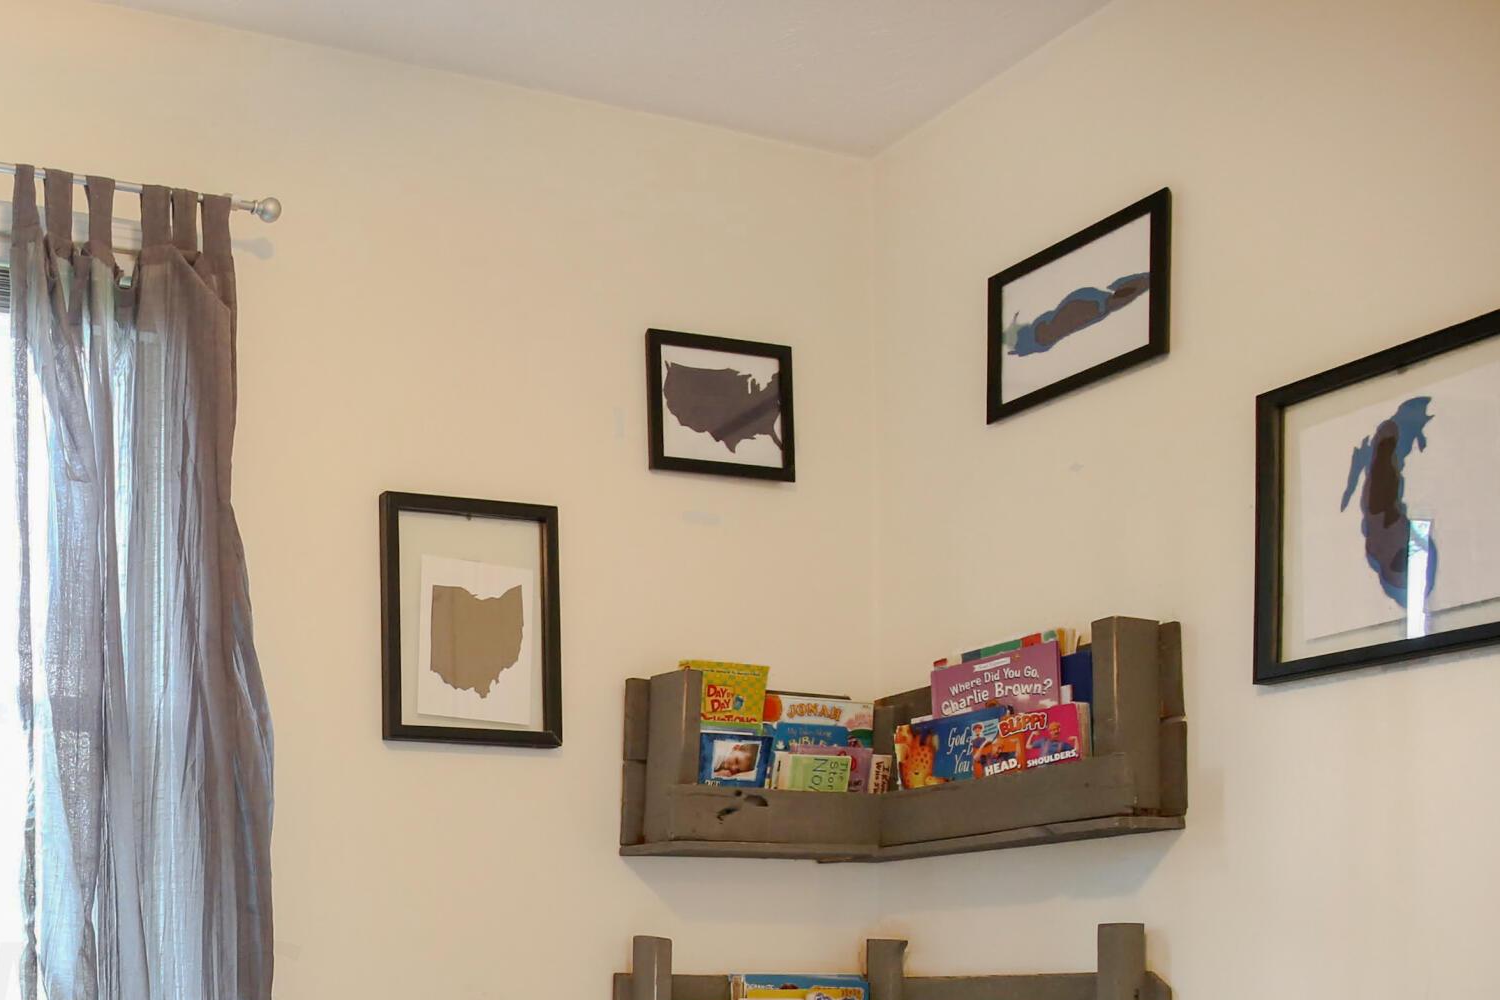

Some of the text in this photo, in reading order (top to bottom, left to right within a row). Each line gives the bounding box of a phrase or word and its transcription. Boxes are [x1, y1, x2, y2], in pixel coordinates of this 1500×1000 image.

[706, 684, 728, 699] DAY
[949, 677, 982, 697] Where
[984, 670, 1000, 684] Did
[1003, 666, 1021, 680] You
[710, 698, 731, 713] DAY
[786, 702, 843, 721] JONAH
[941, 678, 1053, 717] Charlie Brown?
[946, 726, 969, 755] God
[827, 761, 839, 790] Stor
[953, 748, 970, 774] You
[984, 748, 1079, 777] HEAD, SHOULDERS,
